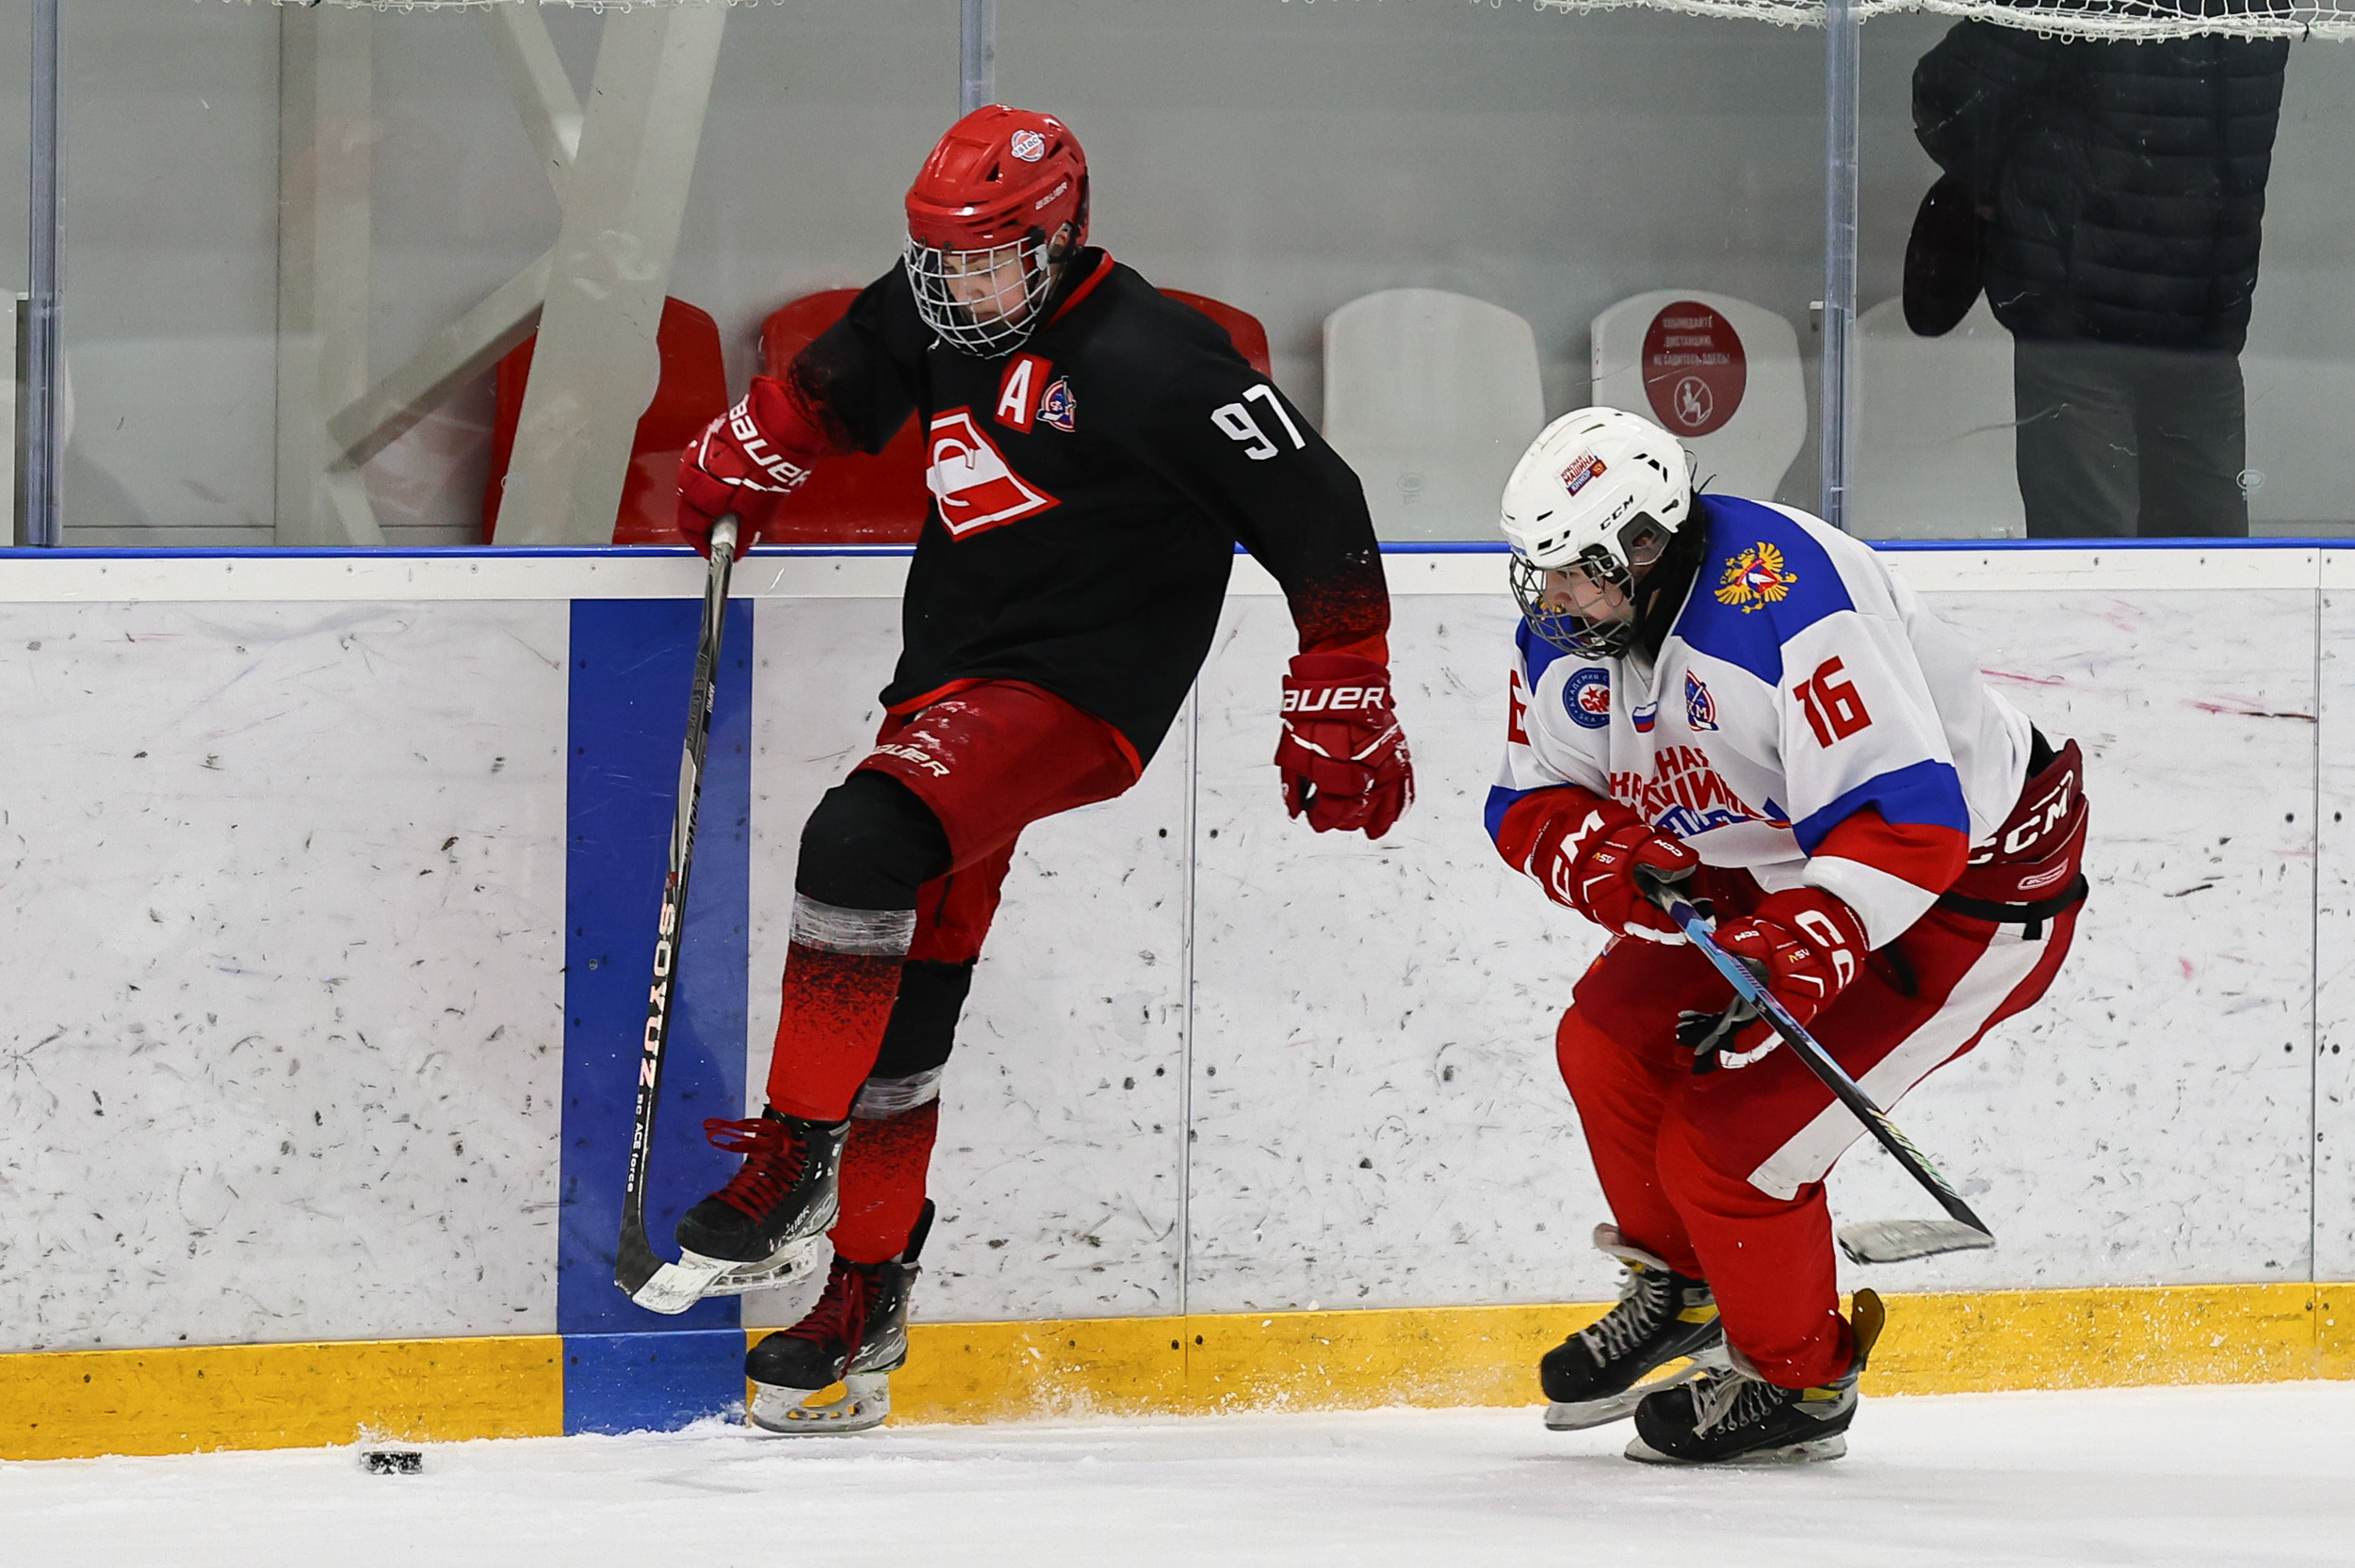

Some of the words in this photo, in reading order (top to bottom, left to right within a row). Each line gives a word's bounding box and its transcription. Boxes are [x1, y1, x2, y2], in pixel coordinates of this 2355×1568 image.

[998, 359, 1033, 425] A
[1210, 383, 1307, 461] 97
[1564, 454, 1595, 487] МАШИНА
[1600, 494, 1634, 531] CCM
[1282, 687, 1386, 712] AUER
[1793, 655, 1872, 749] 16
[873, 743, 950, 778] AUER
[1967, 788, 2070, 865] CCM
[1551, 809, 1606, 906] CM
[1652, 838, 1684, 858] CCM
[1733, 929, 1761, 942] CCM
[1794, 910, 1856, 991] CC
[639, 901, 675, 1090] SOYUZ
[632, 1123, 644, 1151] ACE
[626, 1152, 640, 1193] force
